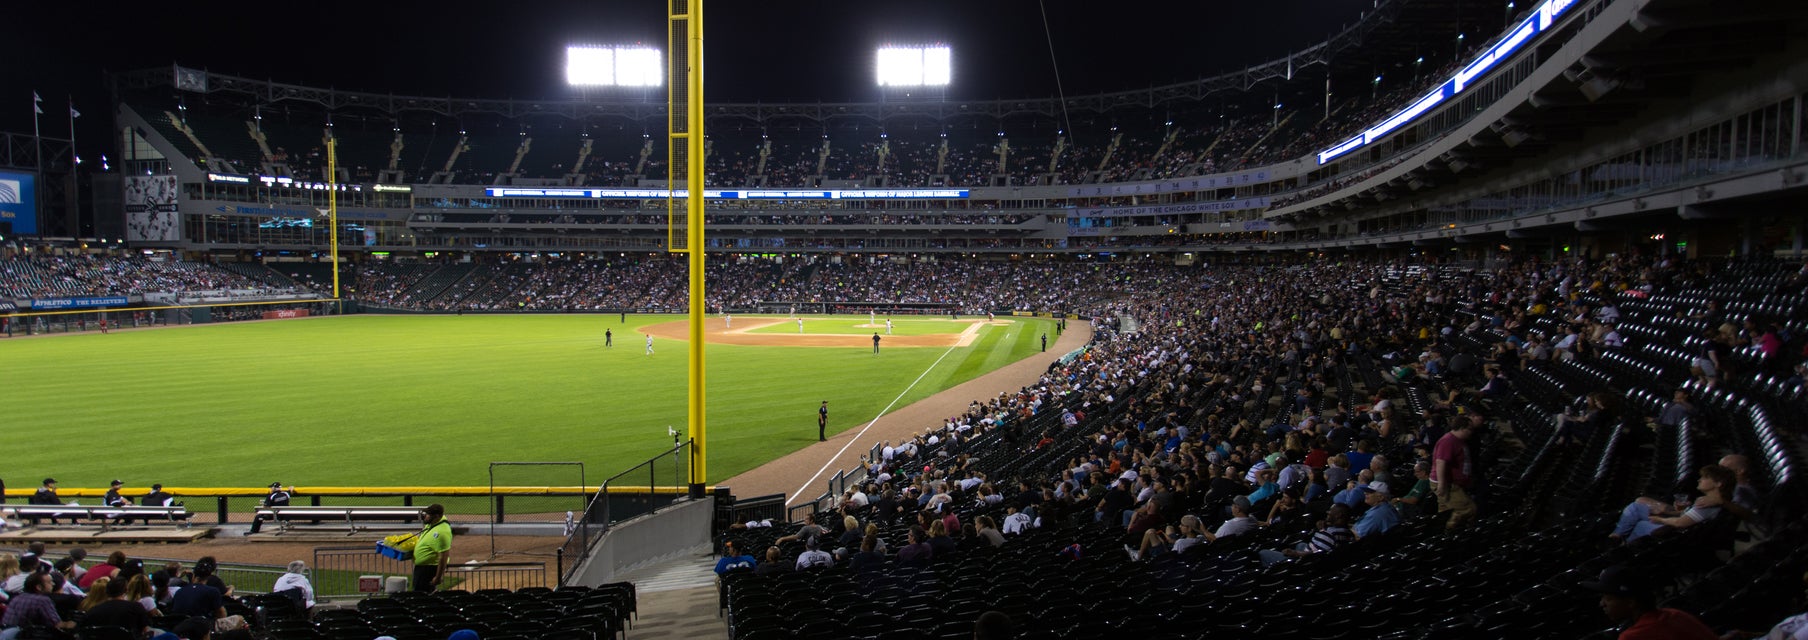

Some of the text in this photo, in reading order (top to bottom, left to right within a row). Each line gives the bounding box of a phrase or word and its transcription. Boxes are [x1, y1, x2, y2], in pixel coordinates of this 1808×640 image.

[1164, 205, 1197, 213] CHICAGO
[1199, 203, 1220, 211] WHITE
[34, 299, 72, 307] ATHLETICO
